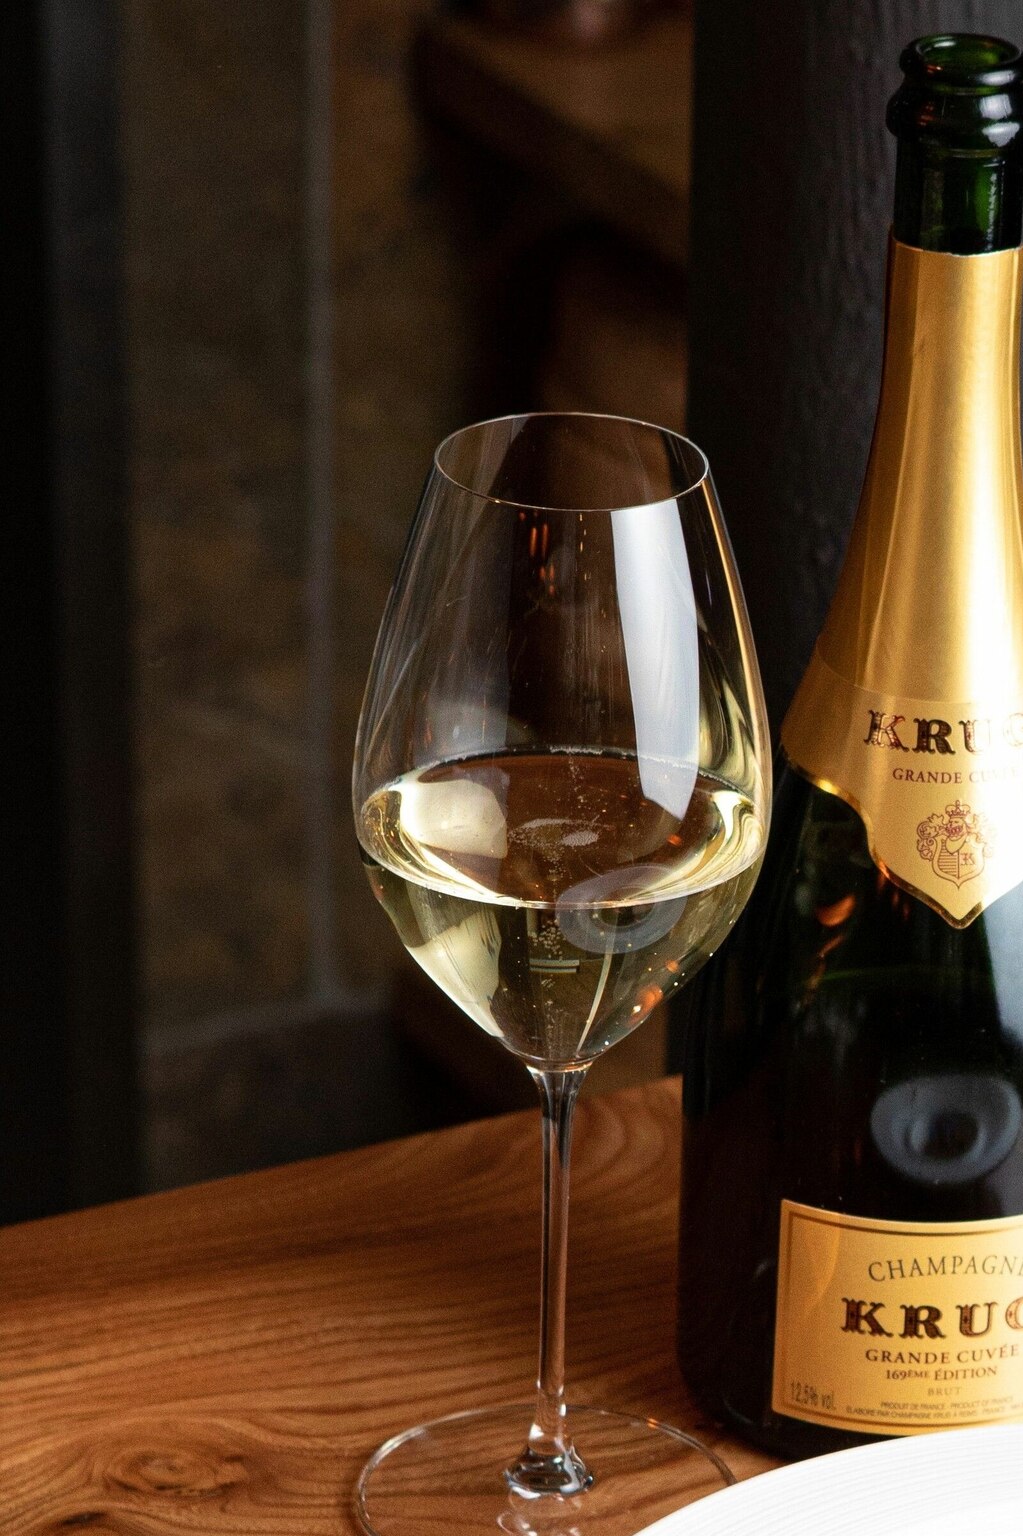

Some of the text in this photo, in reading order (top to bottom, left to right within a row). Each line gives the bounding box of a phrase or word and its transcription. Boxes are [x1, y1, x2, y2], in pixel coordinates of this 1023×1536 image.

[892, 767, 963, 785] GRANDE
[865, 1344, 1020, 1365] GRANDE CUVÉE
[933, 1366, 998, 1382] ÉDITION
[927, 1386, 963, 1397] BRUT
